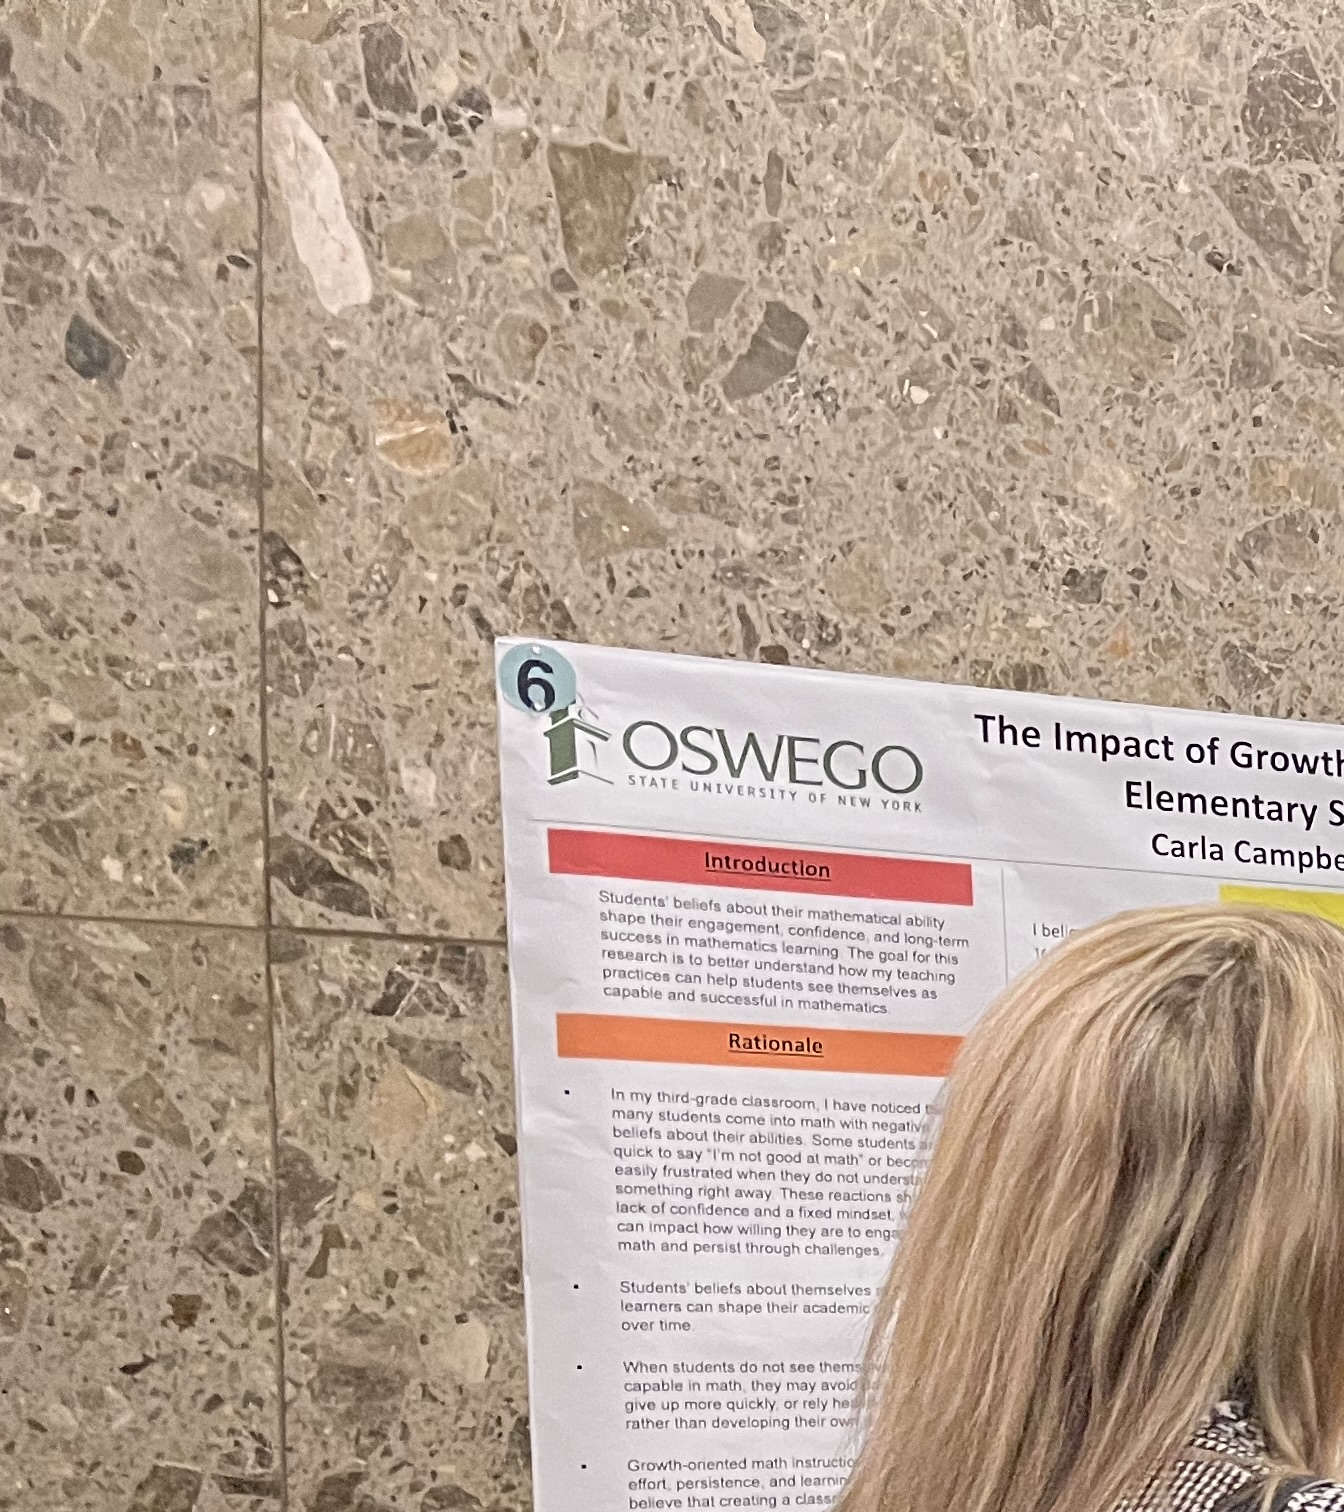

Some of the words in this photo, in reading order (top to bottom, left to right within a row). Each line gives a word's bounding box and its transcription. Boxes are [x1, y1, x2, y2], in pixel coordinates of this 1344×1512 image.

[516, 658, 556, 714] 6
[973, 712, 1041, 749] The
[1054, 721, 1175, 763] Impact
[1185, 735, 1220, 767] of
[622, 720, 924, 794] OSWEGO
[628, 773, 679, 791] STATE
[689, 779, 798, 803] UNIVERSITY
[808, 790, 827, 805] OF
[837, 794, 871, 809] NEW
[880, 798, 922, 814] YORK
[1125, 779, 1318, 832] Elementary
[1151, 832, 1224, 862] Carla
[704, 851, 832, 881] Introduction
[598, 888, 669, 909] Students'
[672, 895, 722, 913] beliefs
[726, 901, 768, 918] about
[771, 903, 804, 919] their
[807, 908, 902, 927] mathematical
[905, 914, 946, 933] ability
[1033, 922, 1037, 936] I
[602, 967, 671, 983] practices
[674, 972, 702, 985] can
[706, 972, 738, 990] help
[742, 974, 804, 992] students
[807, 981, 834, 994] see
[837, 981, 918, 1000] themselves
[921, 988, 938, 1001] as
[728, 1032, 825, 1059] Rationale
[611, 1087, 625, 1102] In
[629, 1091, 653, 1106] my
[656, 1090, 738, 1109] third-grade
[741, 1094, 820, 1113] classroom,
[824, 1097, 828, 1112] I
[832, 1097, 867, 1113] have
[871, 1101, 921, 1116] noticed
[614, 1163, 658, 1182] easily
[662, 1163, 733, 1181] frustrated
[736, 1168, 776, 1183] when
[780, 1168, 811, 1186] they
[814, 1169, 833, 1184] do
[836, 1171, 859, 1185] not
